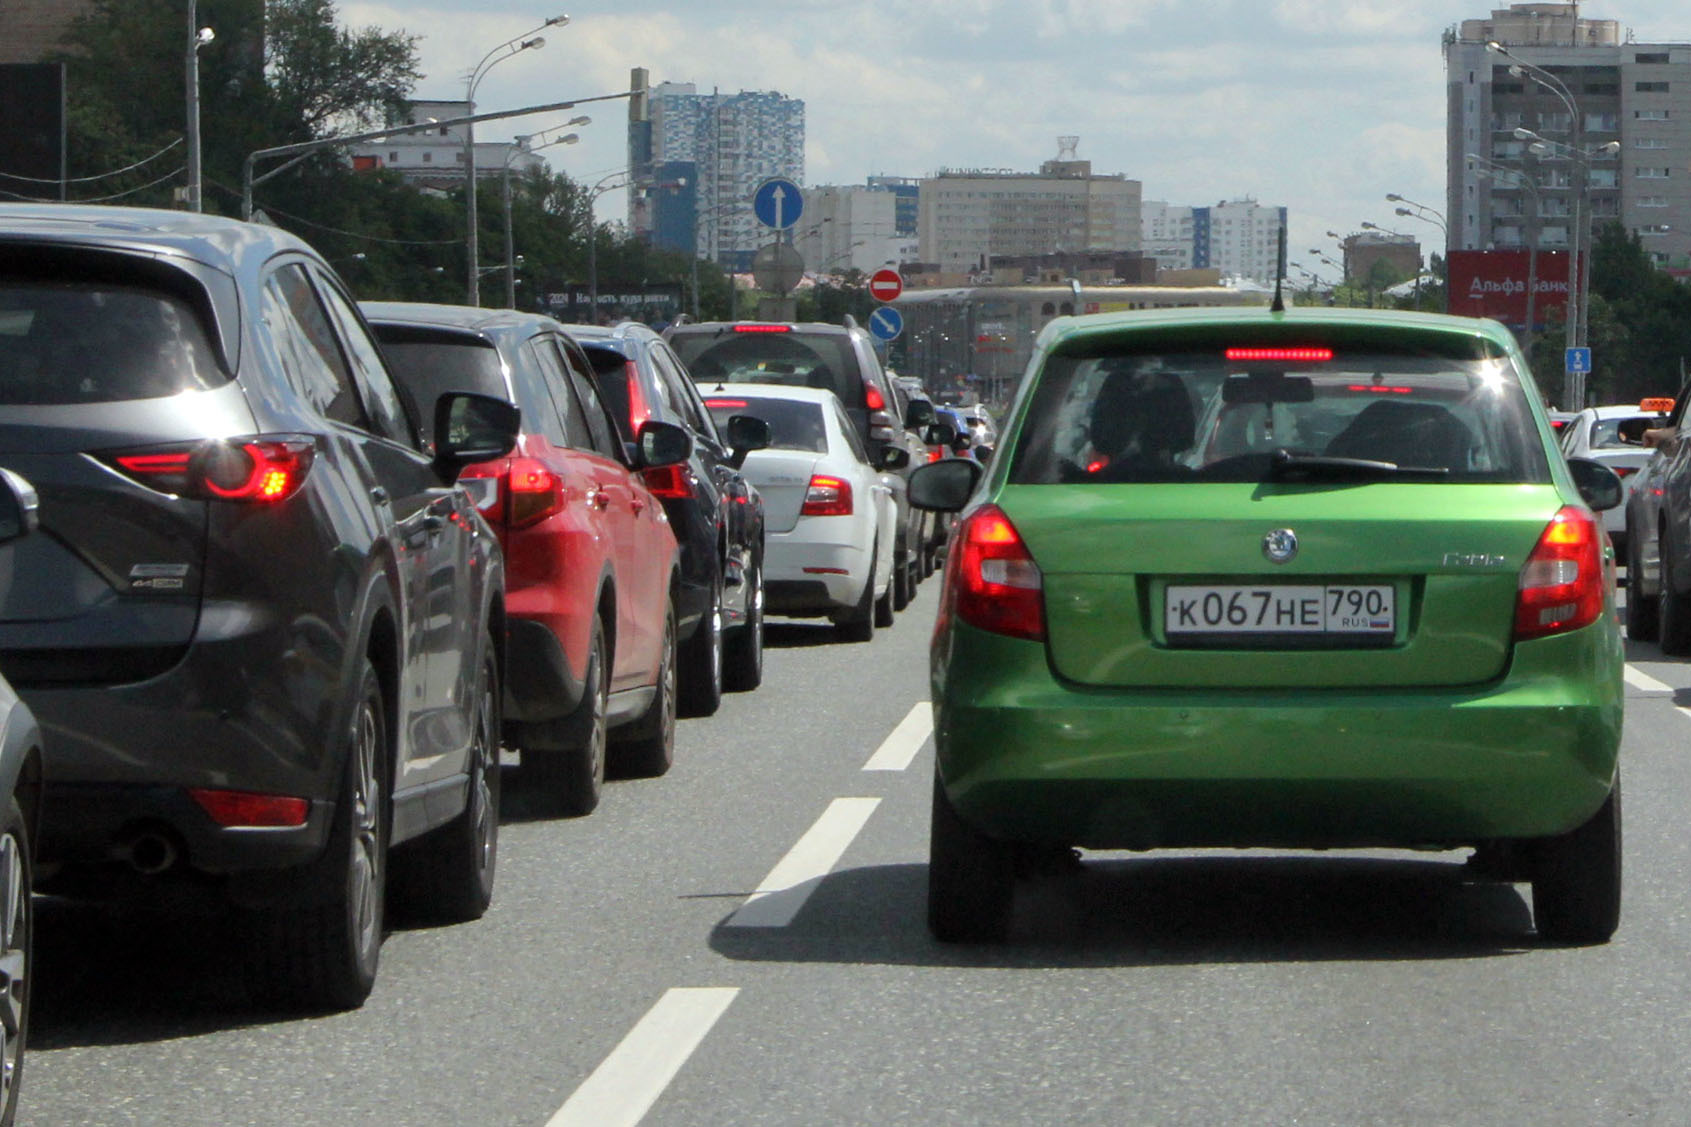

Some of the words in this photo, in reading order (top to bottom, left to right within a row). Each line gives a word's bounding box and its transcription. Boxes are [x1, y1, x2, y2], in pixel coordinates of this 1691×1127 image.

[1469, 276, 1526, 297] Альфа
[1328, 590, 1382, 616] 790
[1342, 618, 1368, 628] RUS
